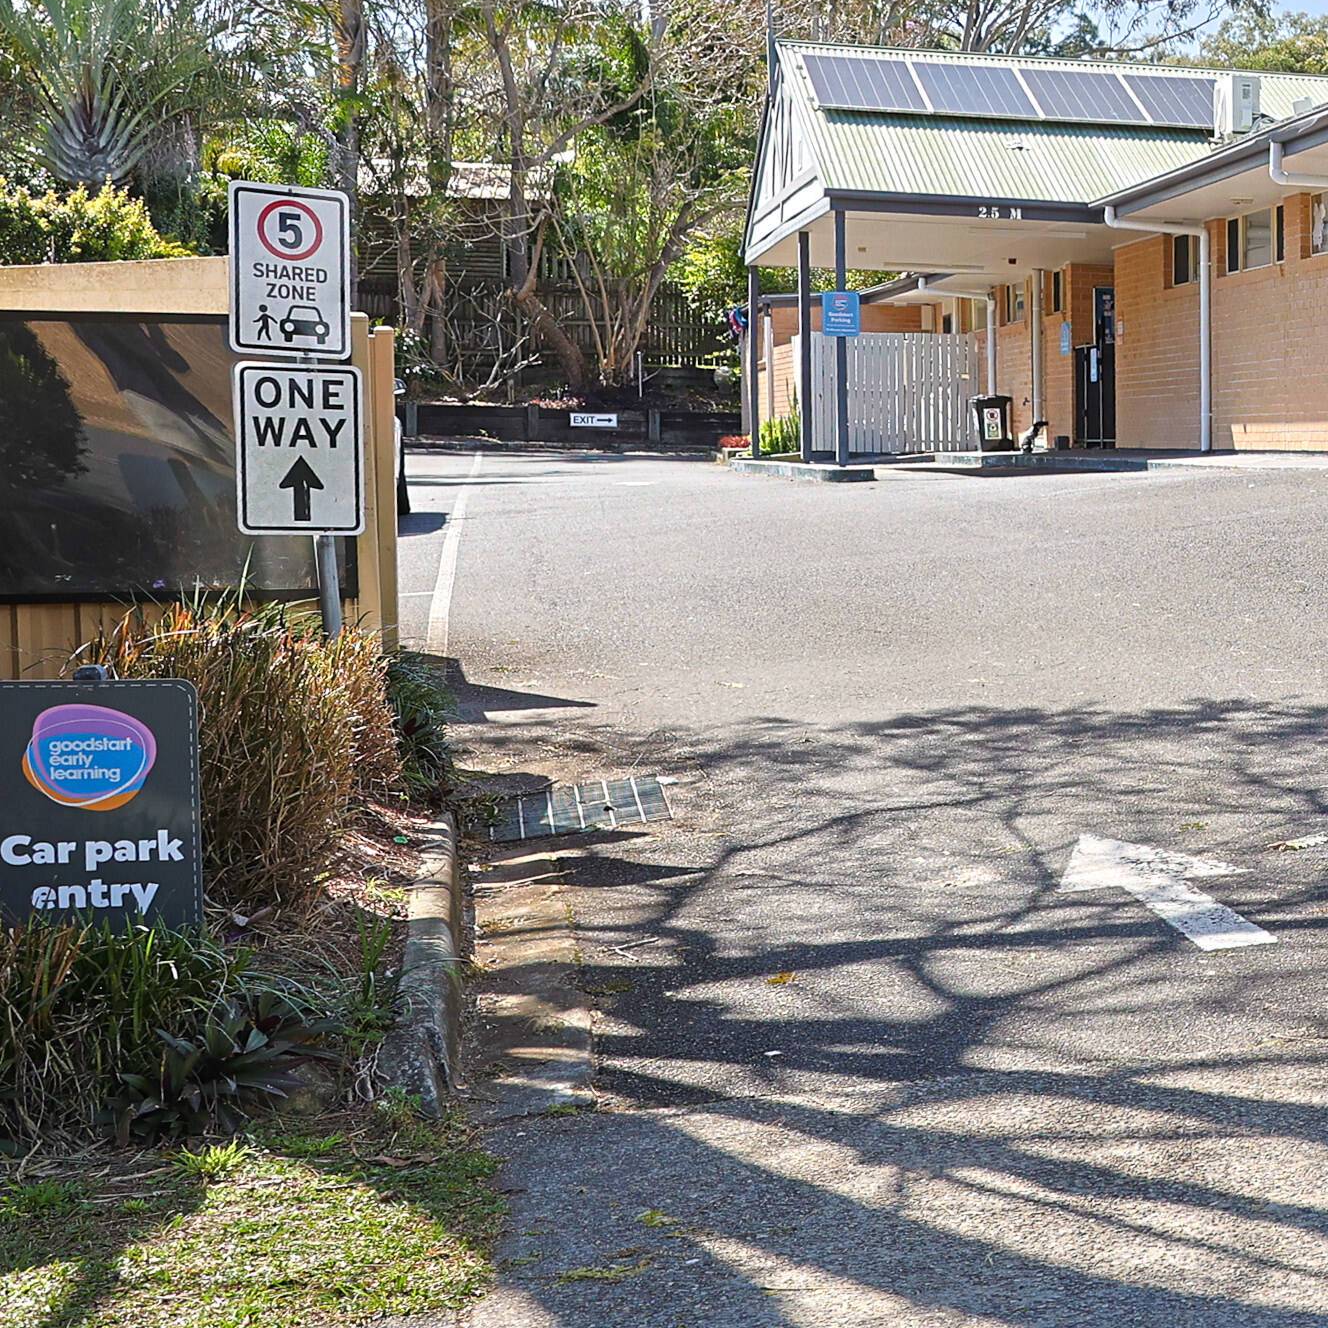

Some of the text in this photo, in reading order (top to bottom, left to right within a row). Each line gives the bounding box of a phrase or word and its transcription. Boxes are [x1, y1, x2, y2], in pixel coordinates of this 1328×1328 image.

[278, 212, 303, 250] 5
[252, 262, 328, 284] SHARED
[266, 282, 316, 302] ZONE
[254, 376, 345, 411] ONE
[573, 415, 595, 424] EXIT
[252, 416, 347, 449] WAY
[49, 737, 132, 755] goodstart
[49, 752, 93, 767] early
[51, 766, 120, 782] learning
[0, 829, 185, 871] Car park
[31, 879, 159, 916] entry
